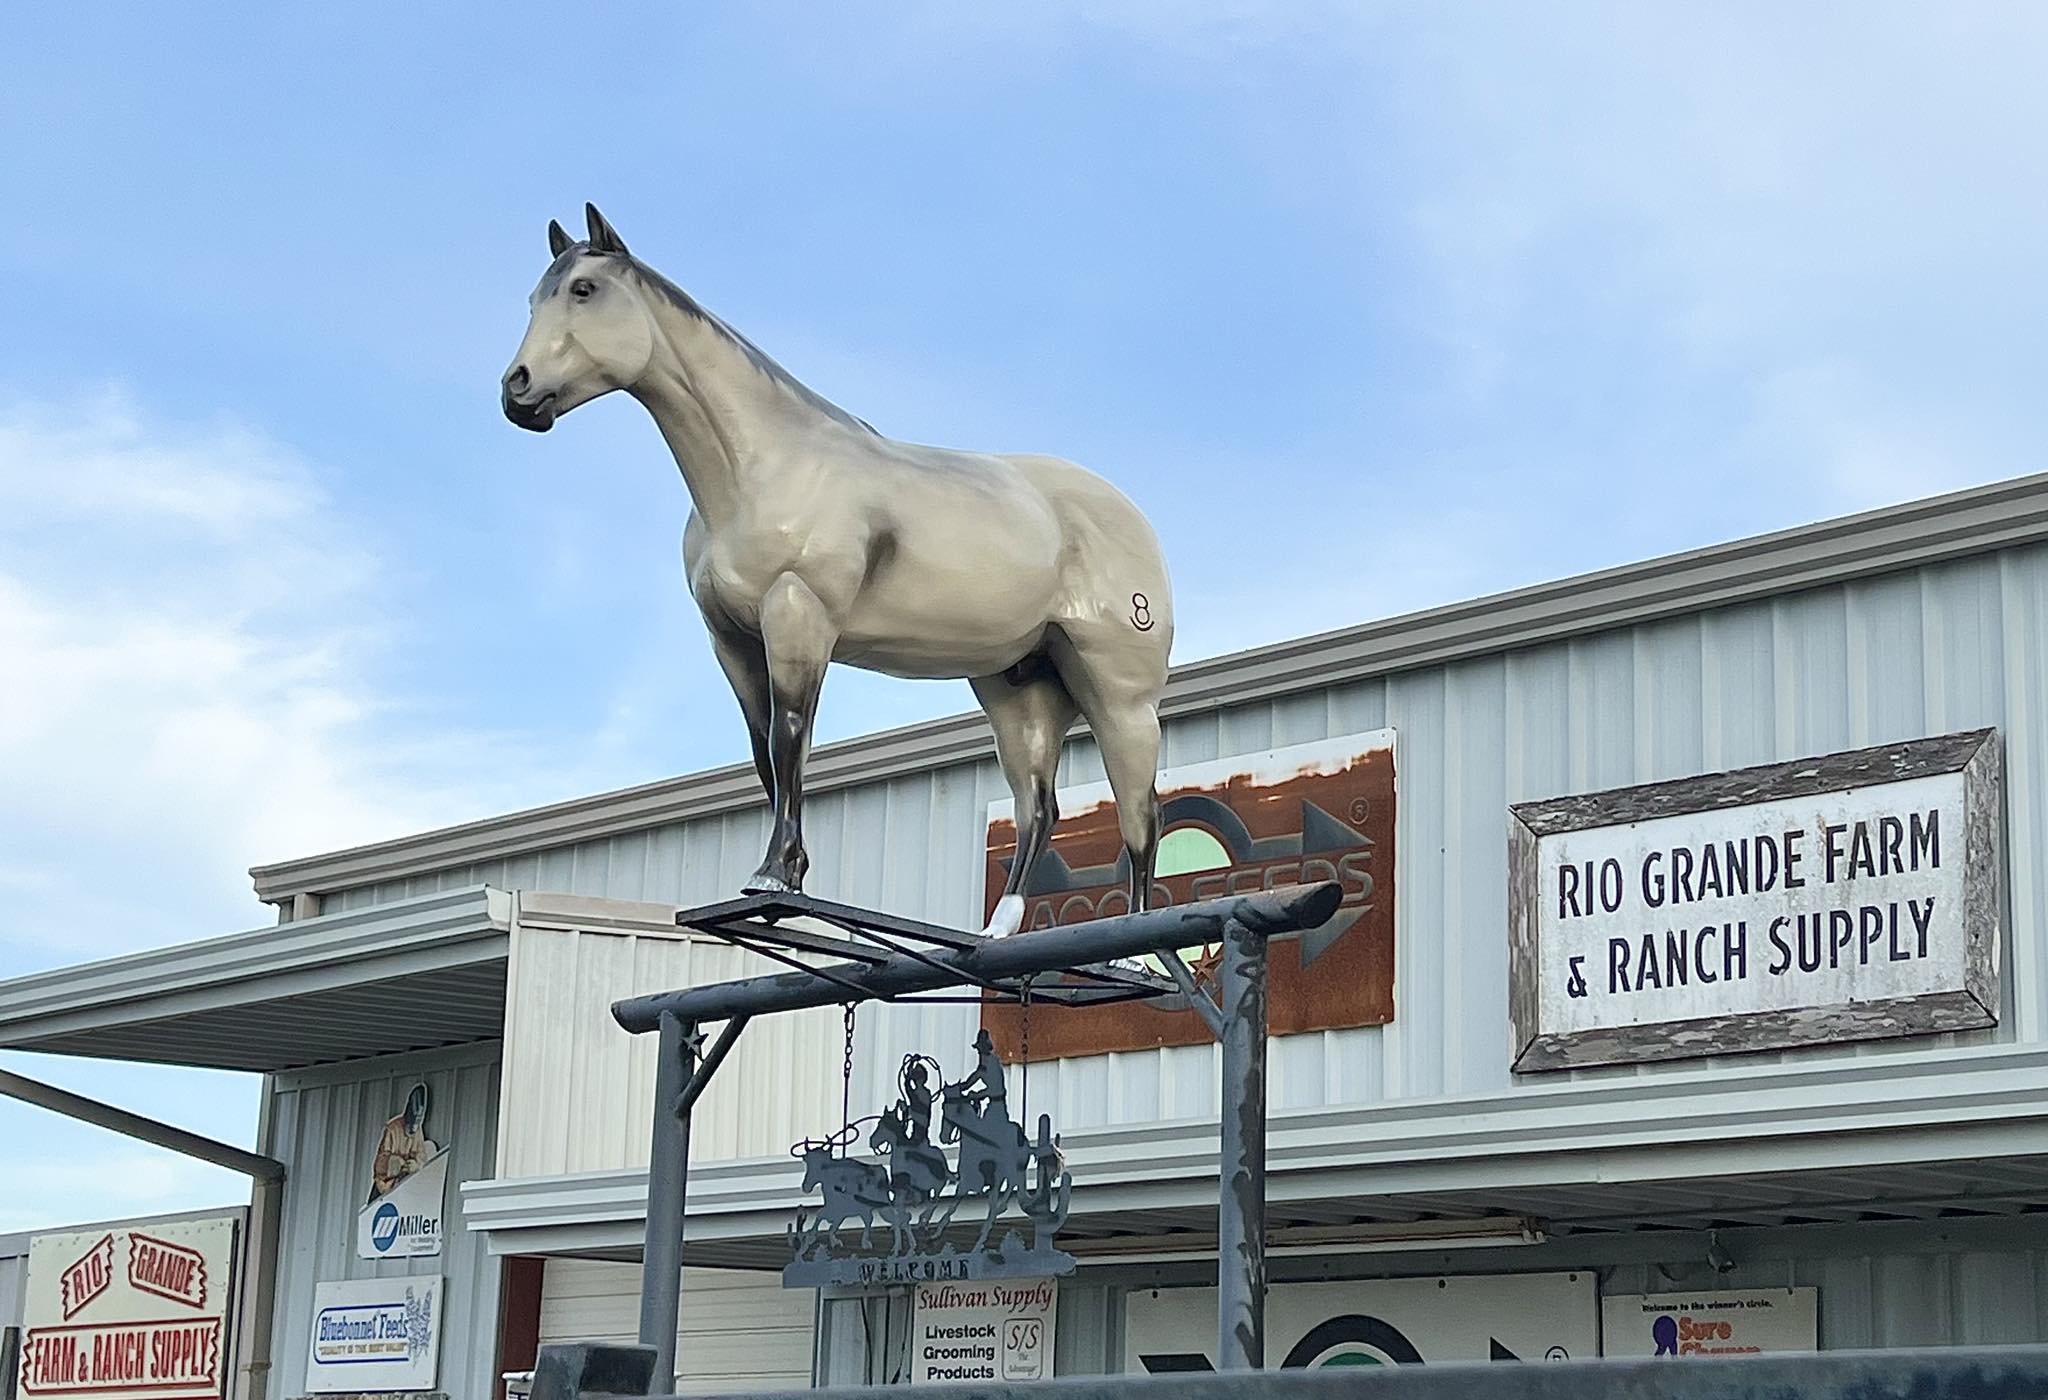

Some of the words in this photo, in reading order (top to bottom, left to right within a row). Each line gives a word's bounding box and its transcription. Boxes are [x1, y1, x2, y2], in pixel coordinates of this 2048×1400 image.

[1558, 858, 1623, 919] RIO
[1641, 829, 1806, 909] GRANDE
[1825, 809, 1941, 884] FARM
[1567, 956, 1588, 999] &
[1608, 921, 1748, 995] RANCH
[1768, 897, 1936, 977] SUPPLY
[399, 1214, 438, 1236] Miller
[72, 1252, 103, 1304] RIO
[135, 1243, 198, 1296] GRANDE
[918, 1285, 988, 1310] Sullivan
[991, 1280, 1054, 1314] Supply
[1680, 1303, 1690, 1311] to
[1691, 1301, 1705, 1311] the
[320, 1315, 378, 1341] Bluebonnet
[378, 1312, 408, 1339] Feeds
[925, 1323, 997, 1340] Livestock
[1679, 1316, 1732, 1341] Sure
[33, 1337, 77, 1384] FARM
[78, 1352, 89, 1382] &
[92, 1332, 147, 1381] RANCH
[150, 1327, 212, 1378] SUPPLY
[923, 1344, 995, 1362] Grooming
[927, 1366, 995, 1381] Products
